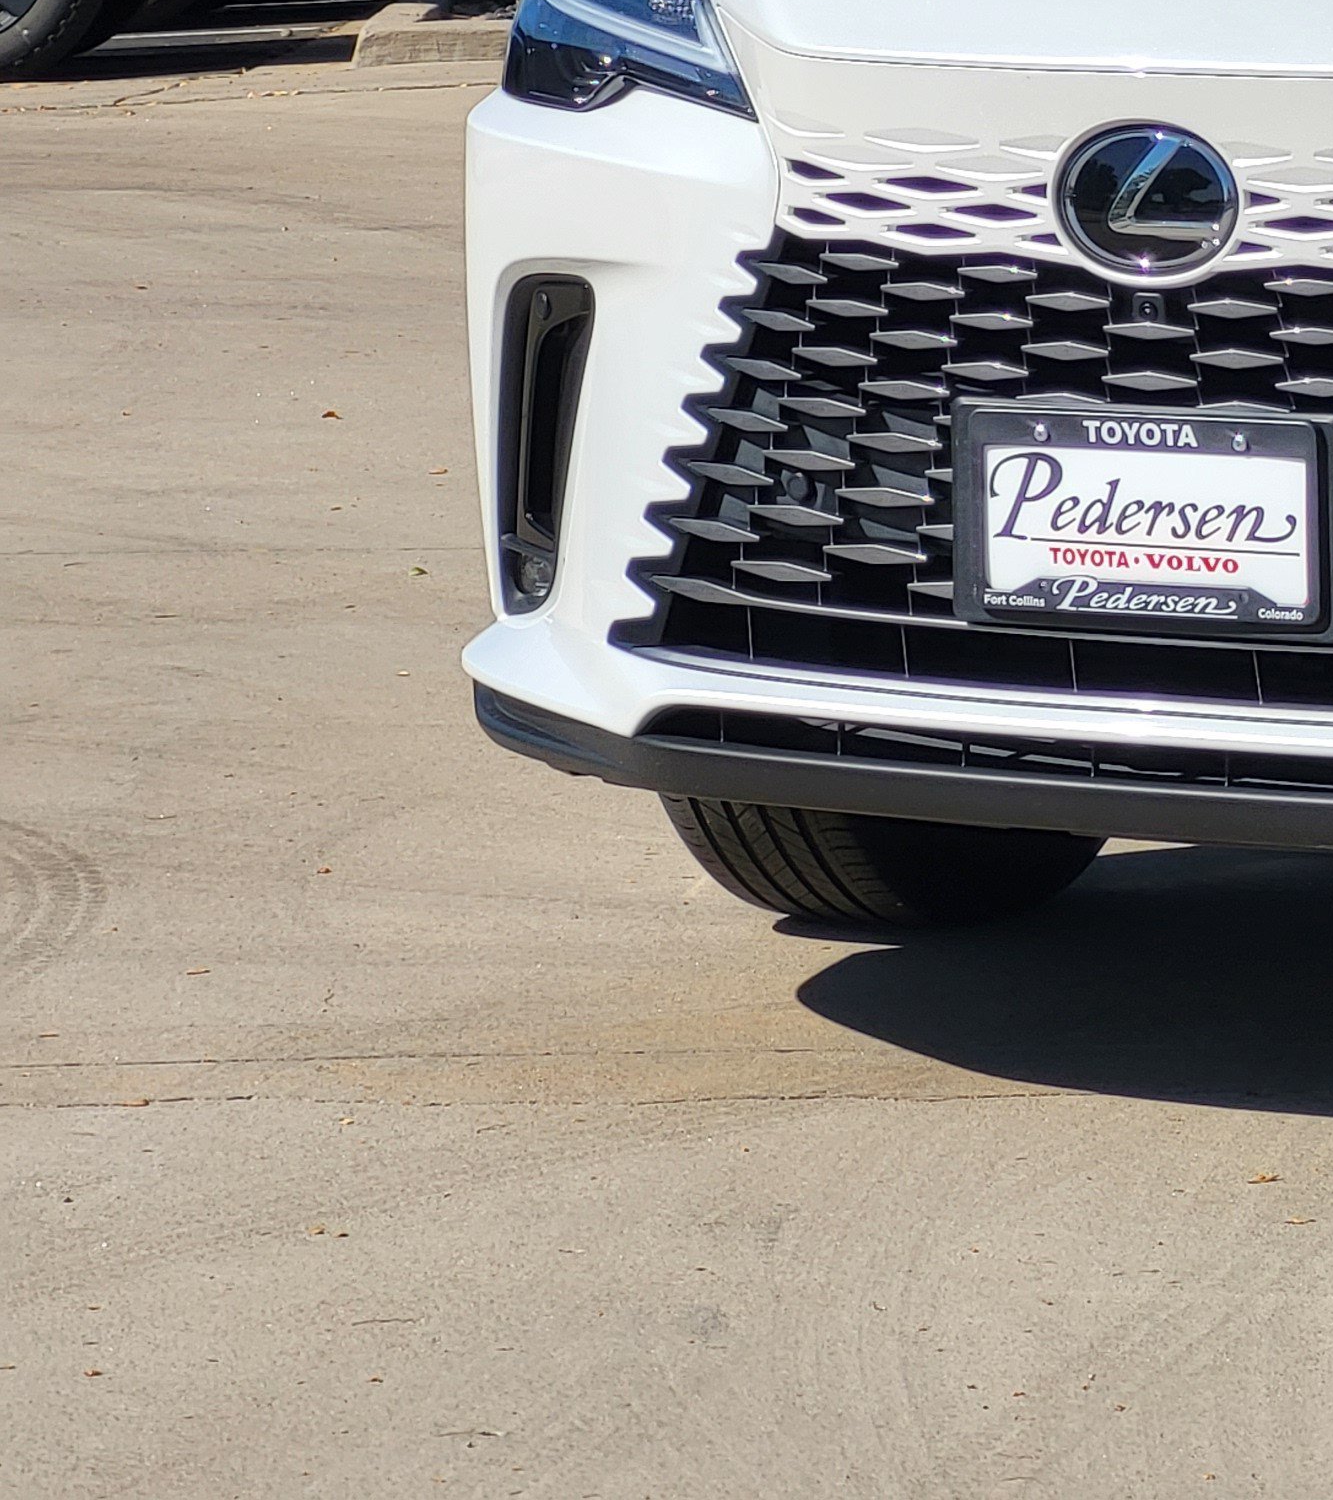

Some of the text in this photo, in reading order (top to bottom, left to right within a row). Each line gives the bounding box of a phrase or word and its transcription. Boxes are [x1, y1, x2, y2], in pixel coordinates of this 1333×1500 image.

[1082, 420, 1198, 448] TOYOTA
[990, 452, 1297, 543] Pedersen
[1049, 547, 1239, 574] TOYOTA VOLVO
[984, 593, 1046, 608] Fort Collins
[1052, 575, 1238, 615] Pedersen
[1257, 607, 1304, 623] Colorado
